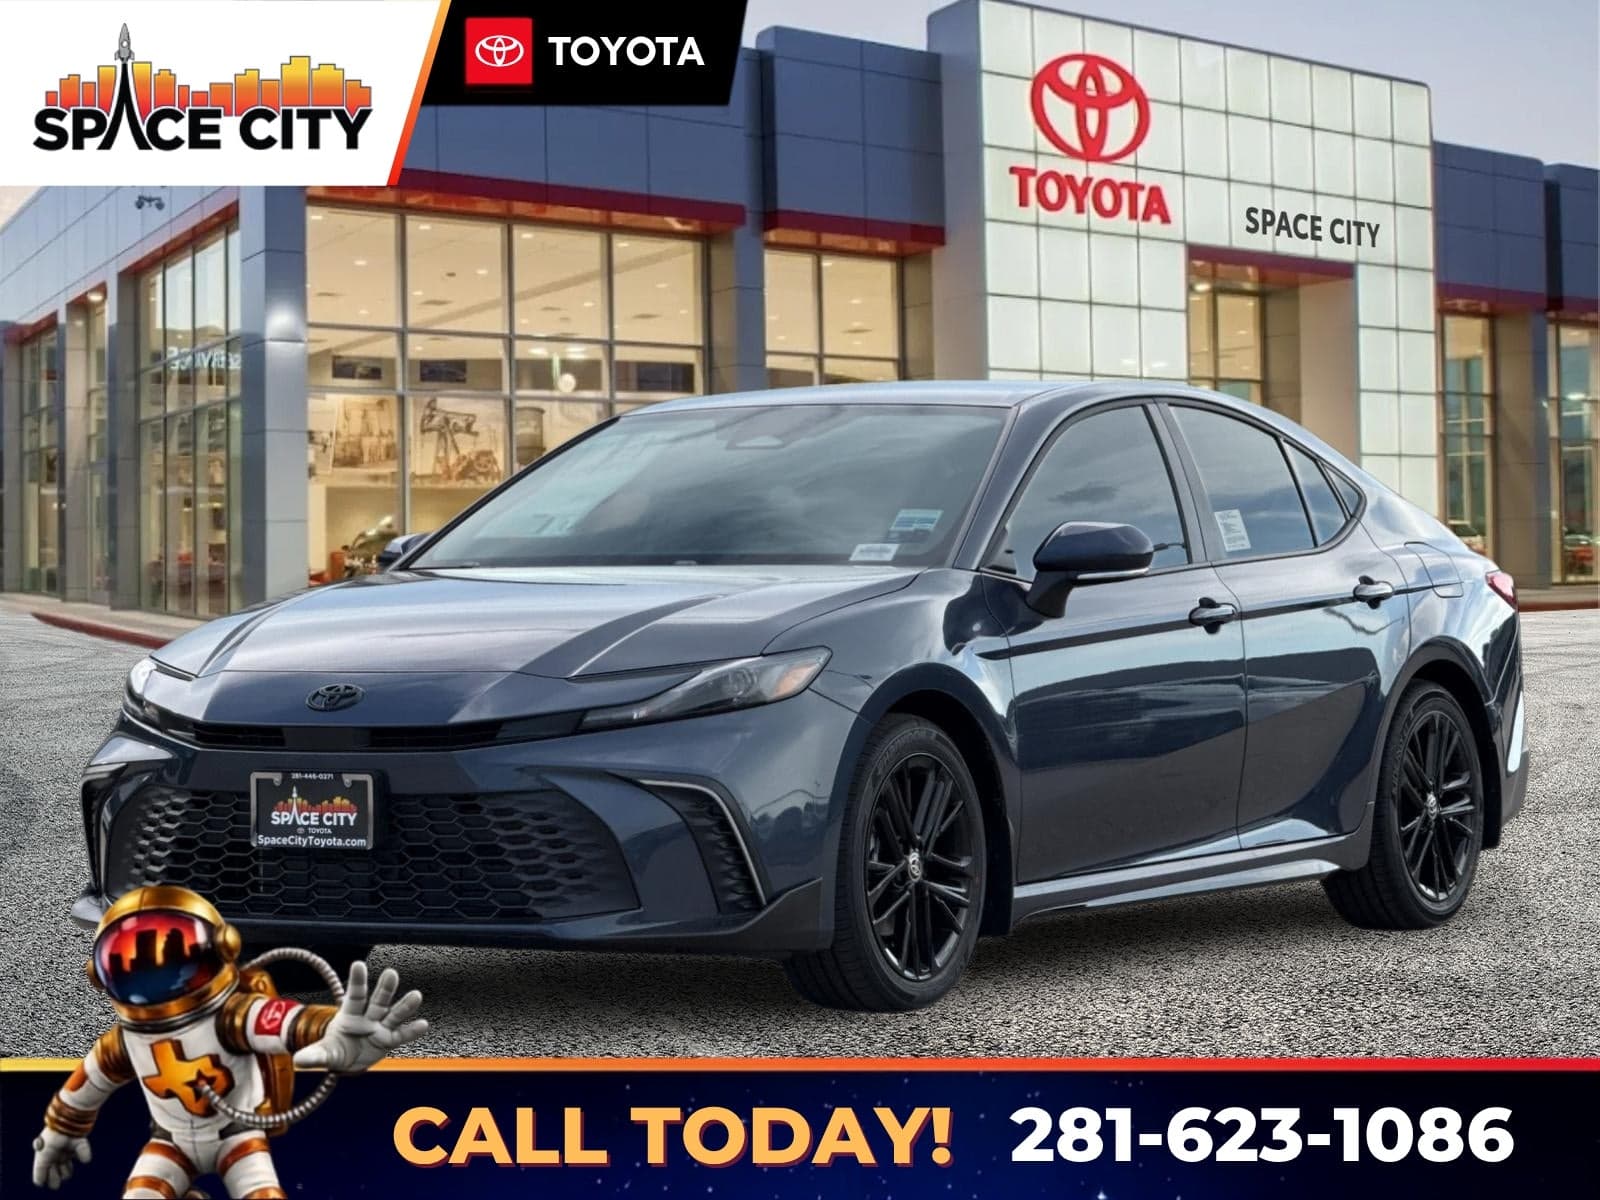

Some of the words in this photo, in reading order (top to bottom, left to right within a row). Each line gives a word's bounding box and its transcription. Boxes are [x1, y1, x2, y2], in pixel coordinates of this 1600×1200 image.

[1009, 165, 1172, 225] TOYOTA
[1245, 206, 1323, 242] SPACE
[1329, 217, 1381, 248] CITY
[270, 811, 319, 825] SPACE
[322, 812, 357, 826] CITY
[258, 835, 367, 847] SpaceCityToyota.com
